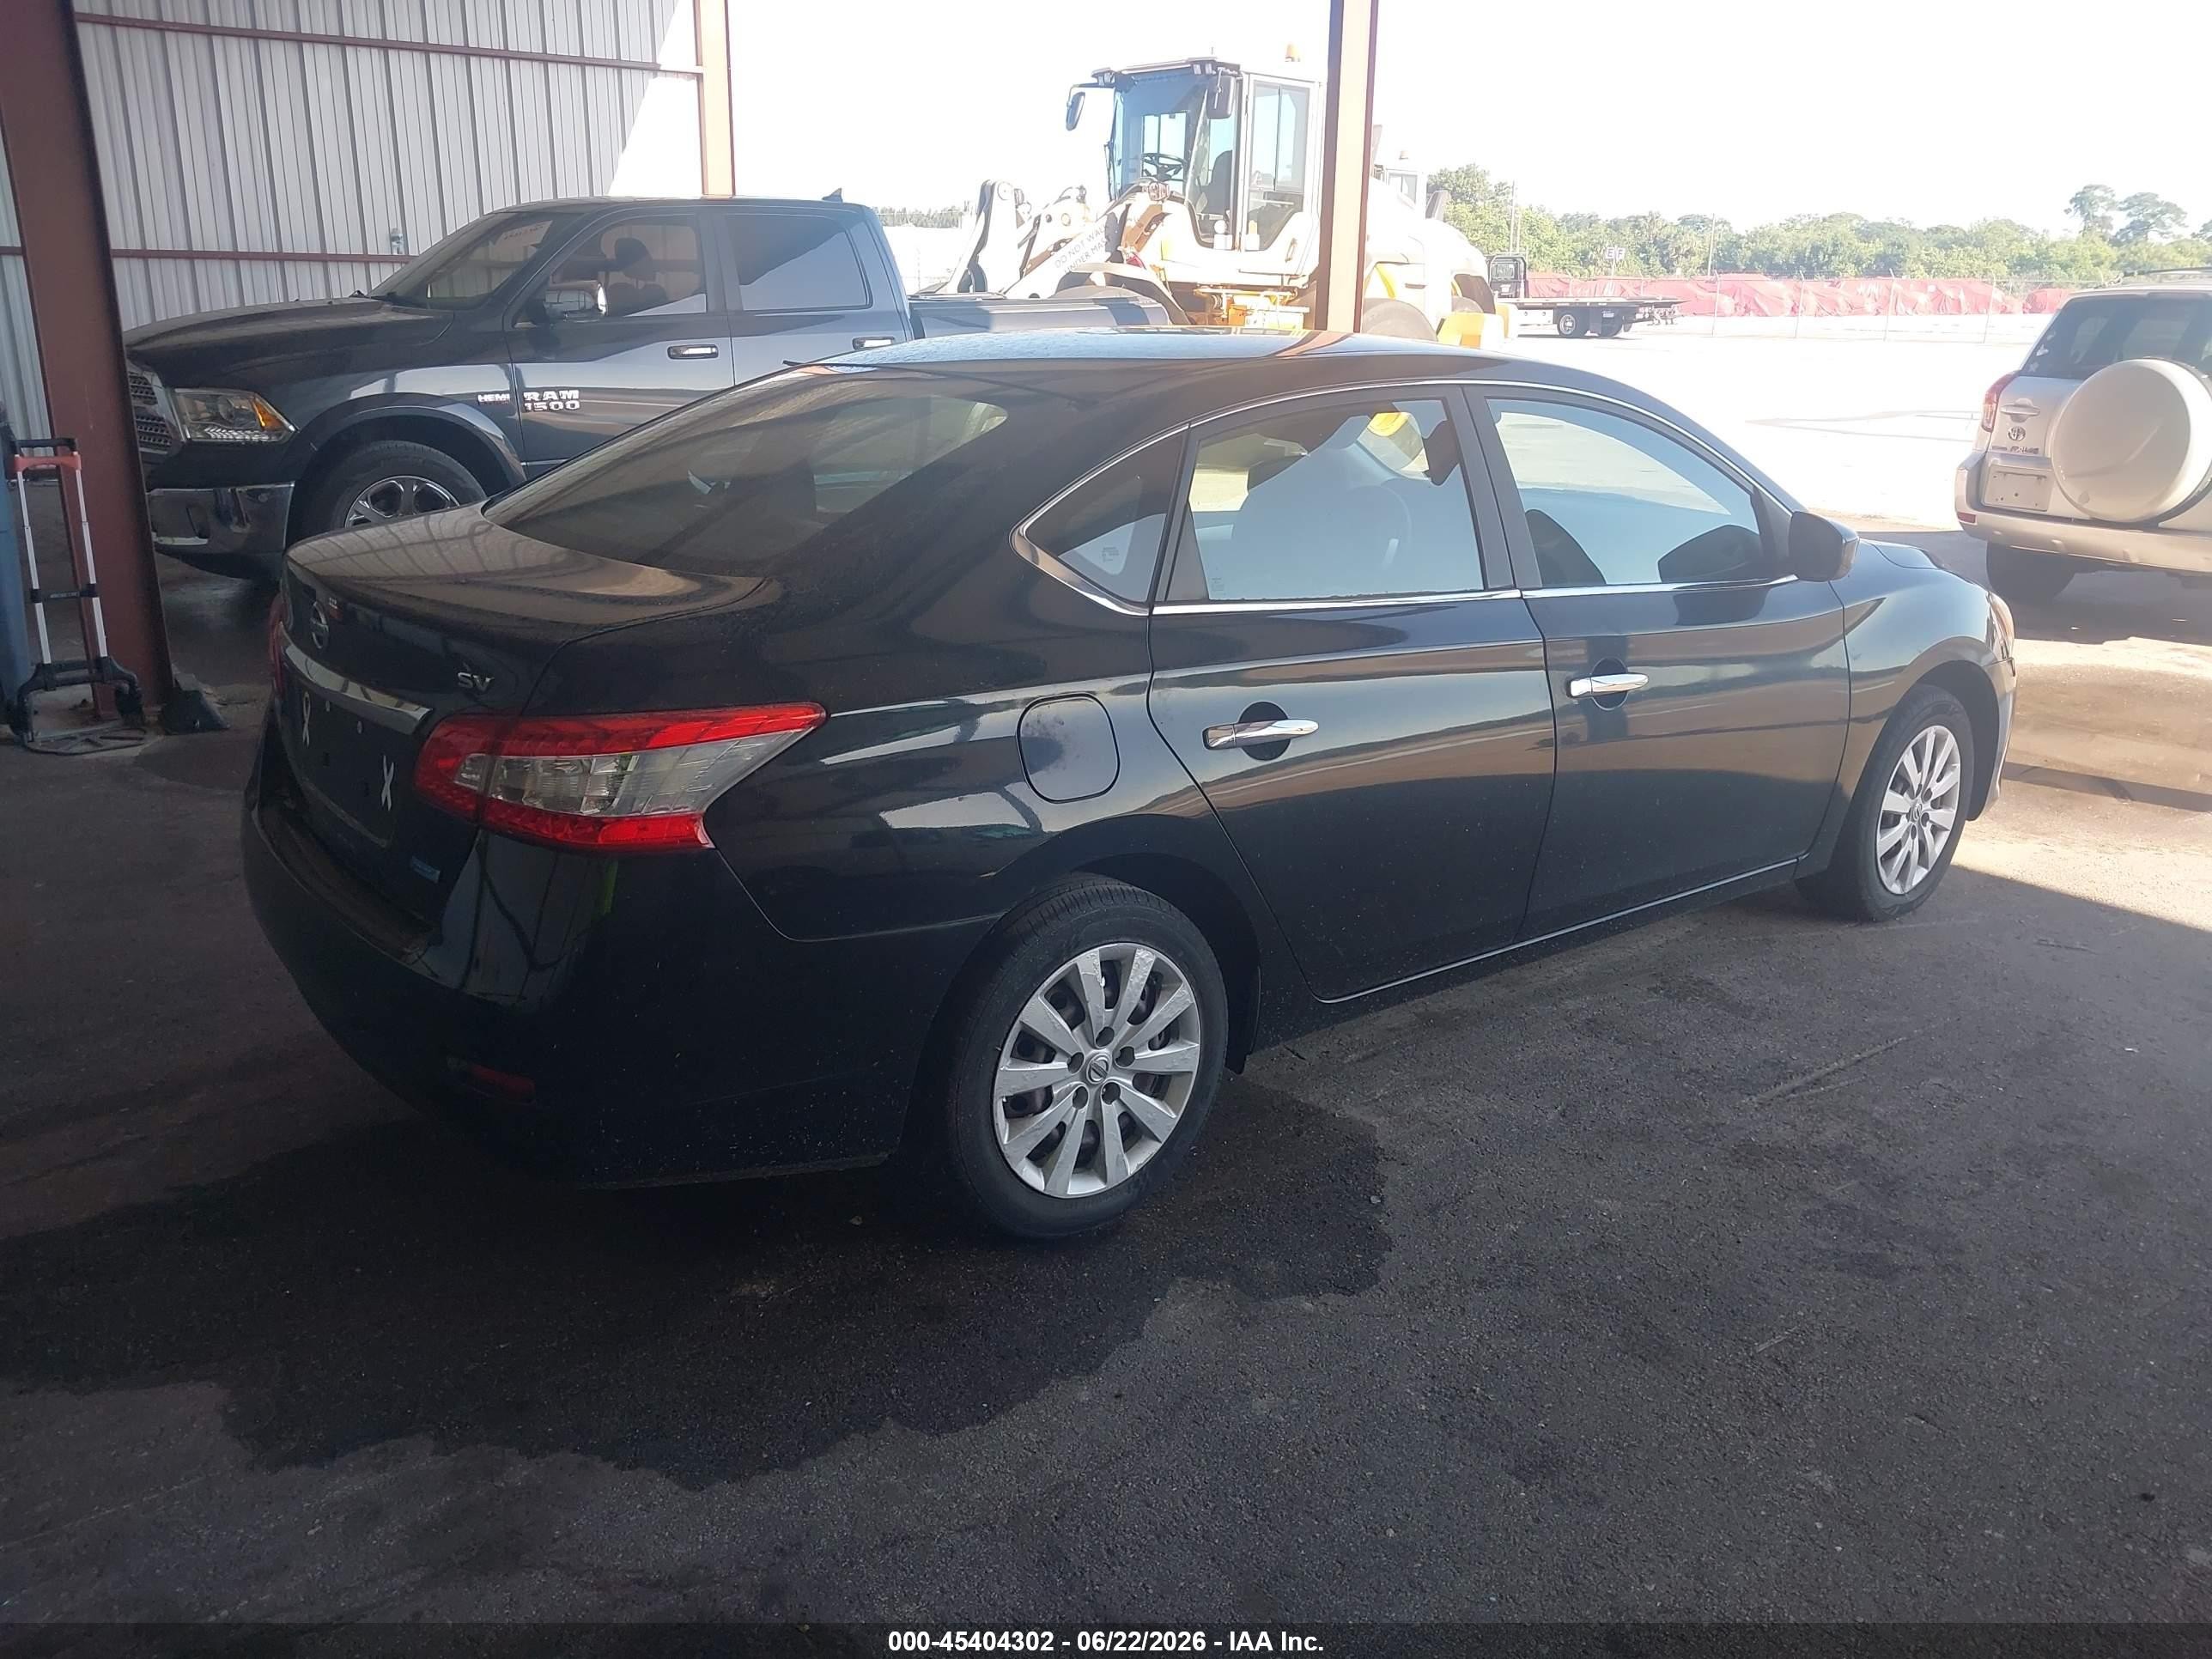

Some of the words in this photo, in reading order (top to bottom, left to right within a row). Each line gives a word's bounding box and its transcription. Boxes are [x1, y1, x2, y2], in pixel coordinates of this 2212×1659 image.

[477, 393, 510, 402] HEMI
[523, 389, 580, 402] RAM
[524, 400, 580, 411] 1500
[457, 672, 495, 692] SV
